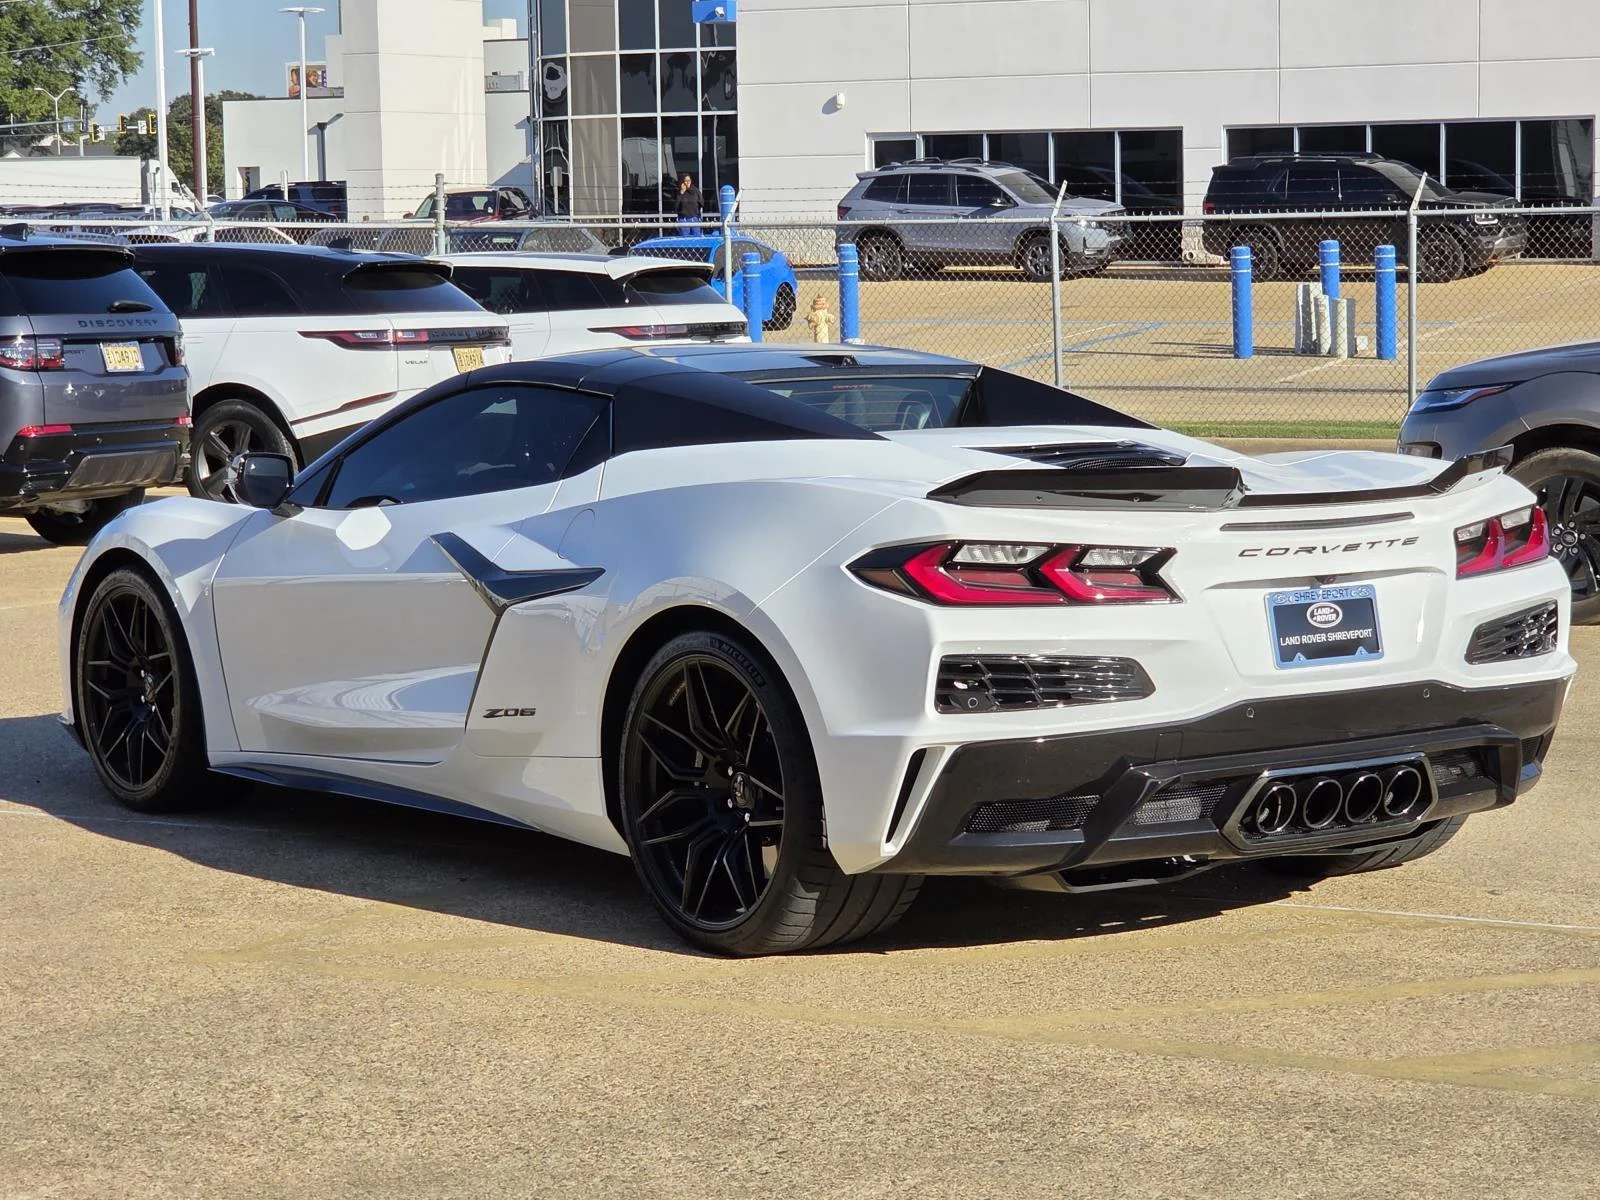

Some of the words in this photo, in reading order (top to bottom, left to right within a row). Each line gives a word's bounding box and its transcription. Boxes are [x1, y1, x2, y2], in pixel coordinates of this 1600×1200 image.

[78, 319, 158, 328] DISCOVERY
[1238, 536, 1419, 557] CORVETTE
[1294, 588, 1349, 602] SHREVEPORT
[1313, 607, 1331, 615] LAND
[1316, 613, 1337, 622] ROVER
[1280, 636, 1301, 646] LAND
[1301, 633, 1326, 644] ROVER
[1327, 628, 1372, 641] SHREVEPORT
[482, 707, 537, 719] Z06
